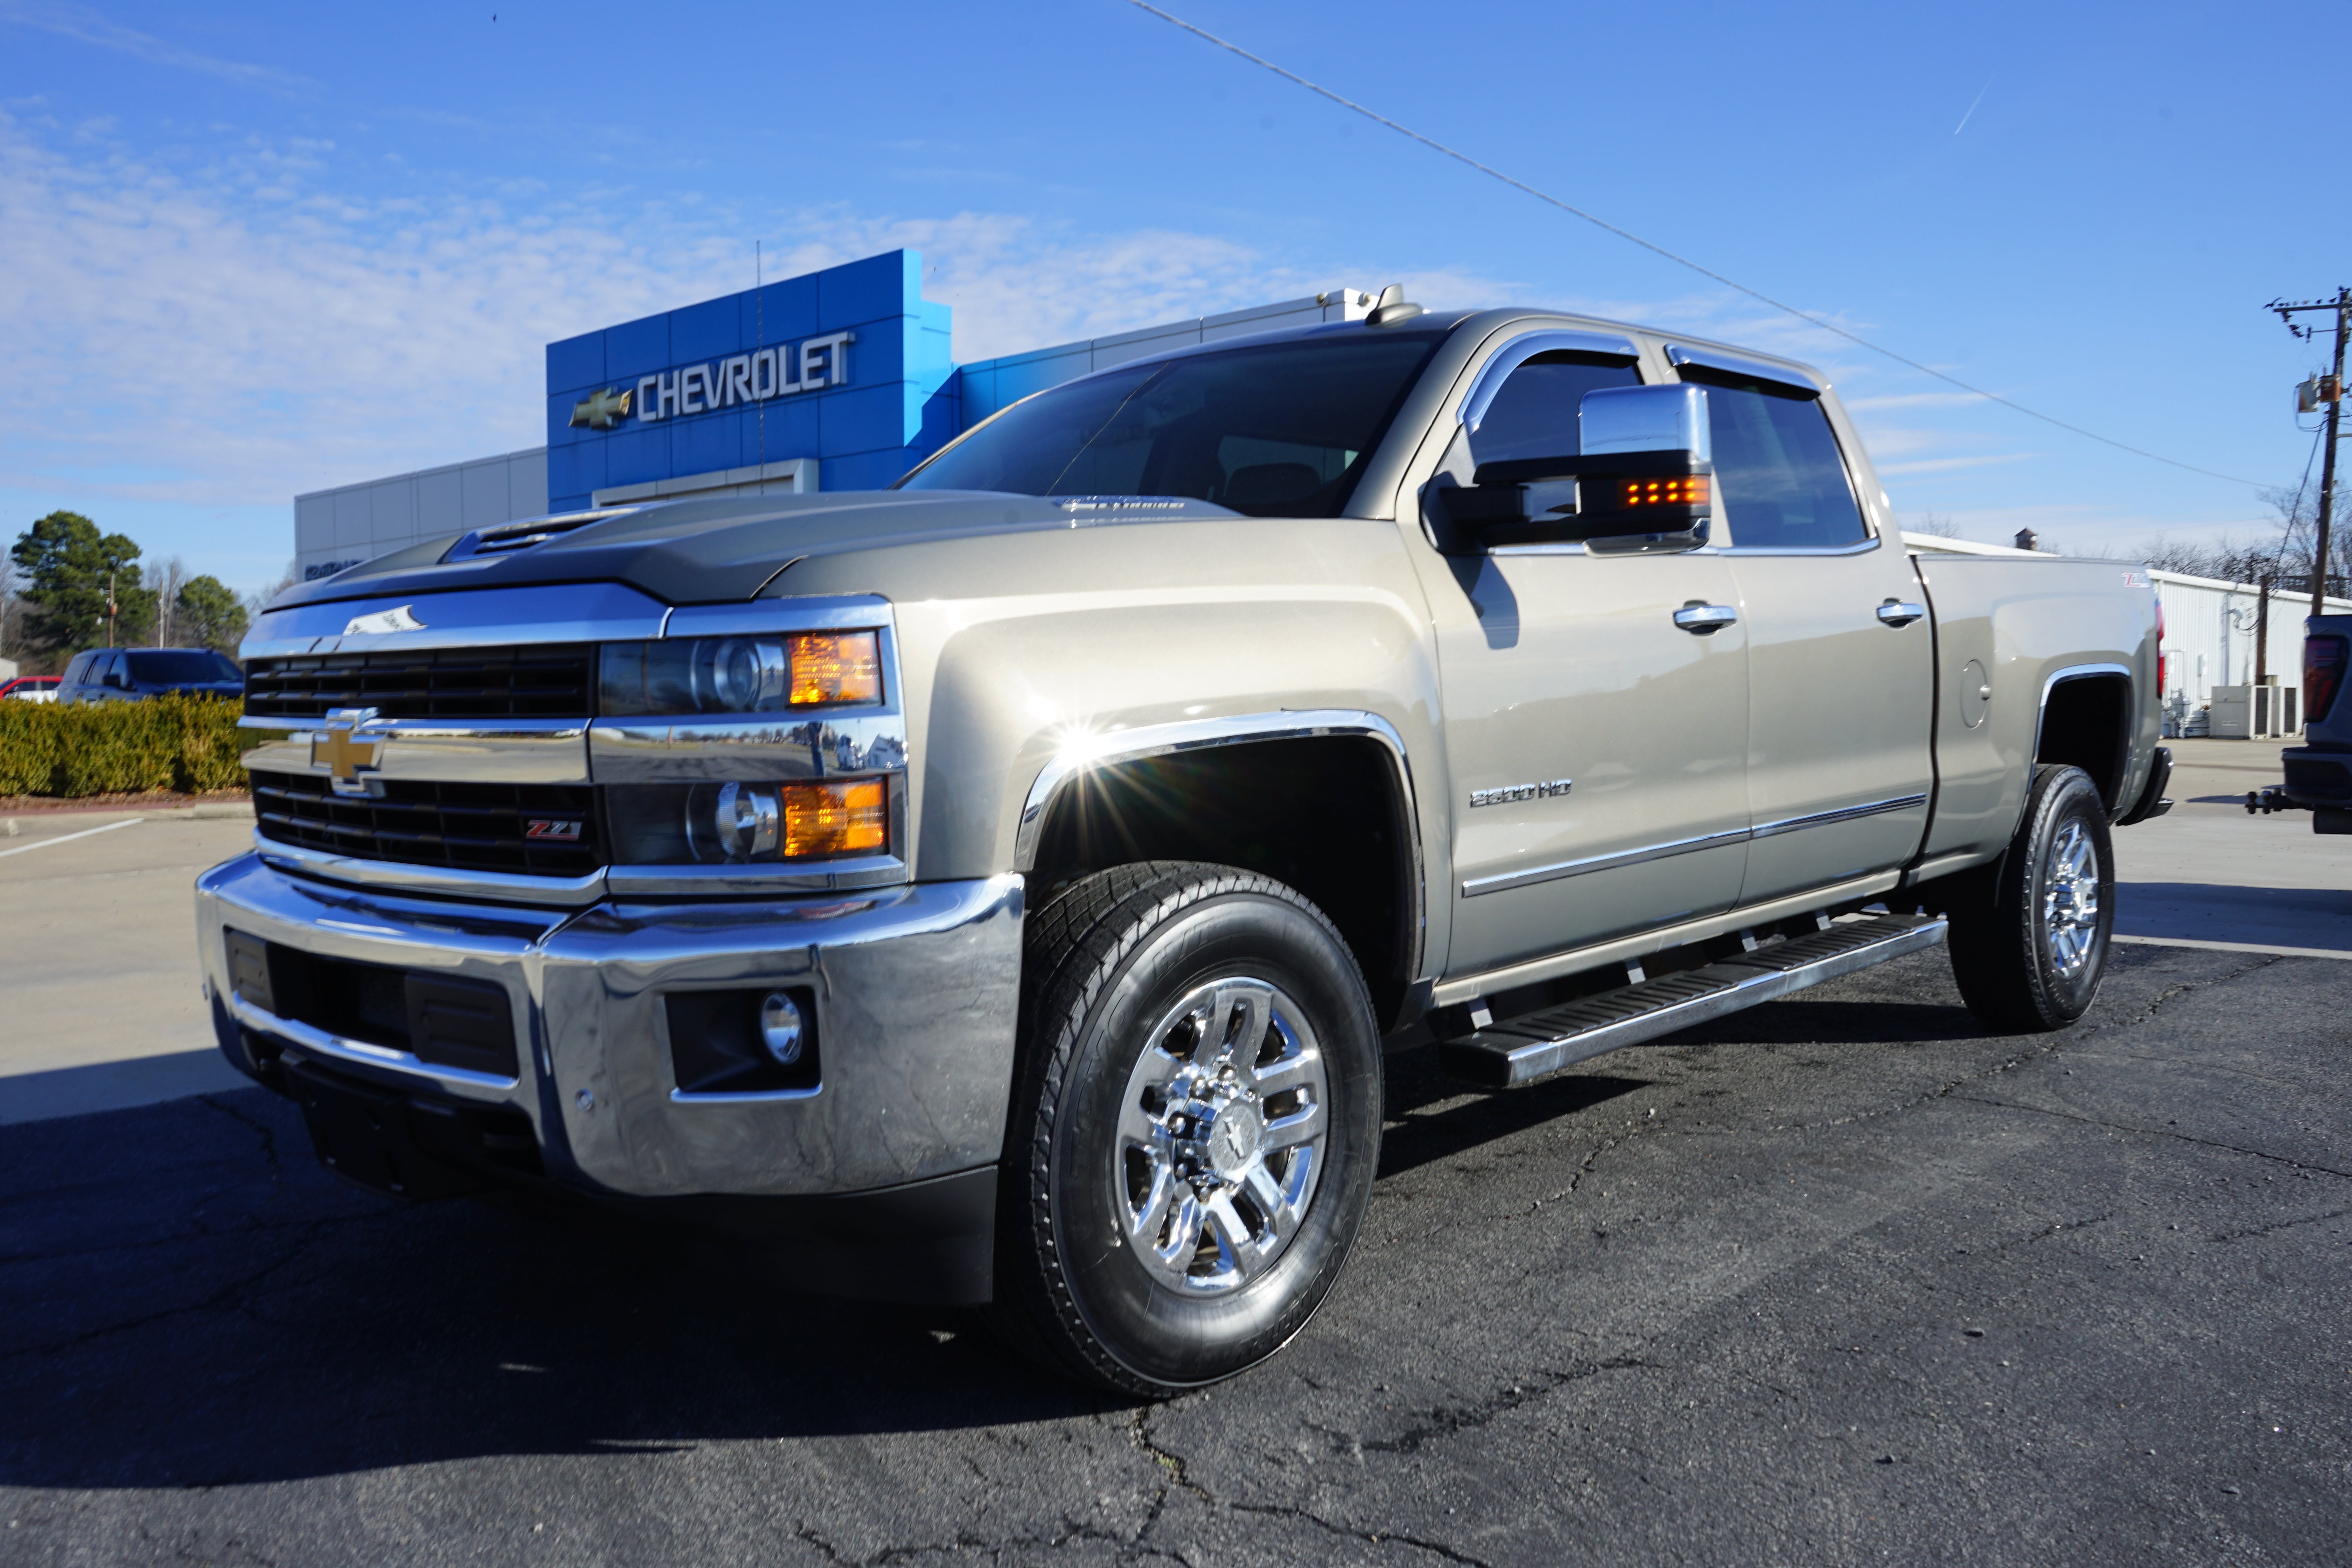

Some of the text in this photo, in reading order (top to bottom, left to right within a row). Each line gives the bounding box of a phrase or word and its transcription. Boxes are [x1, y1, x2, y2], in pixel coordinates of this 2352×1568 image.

[637, 332, 855, 422] CHEVROLET
[1470, 779, 1572, 808] 2500 HD
[526, 819, 583, 841] Z71
